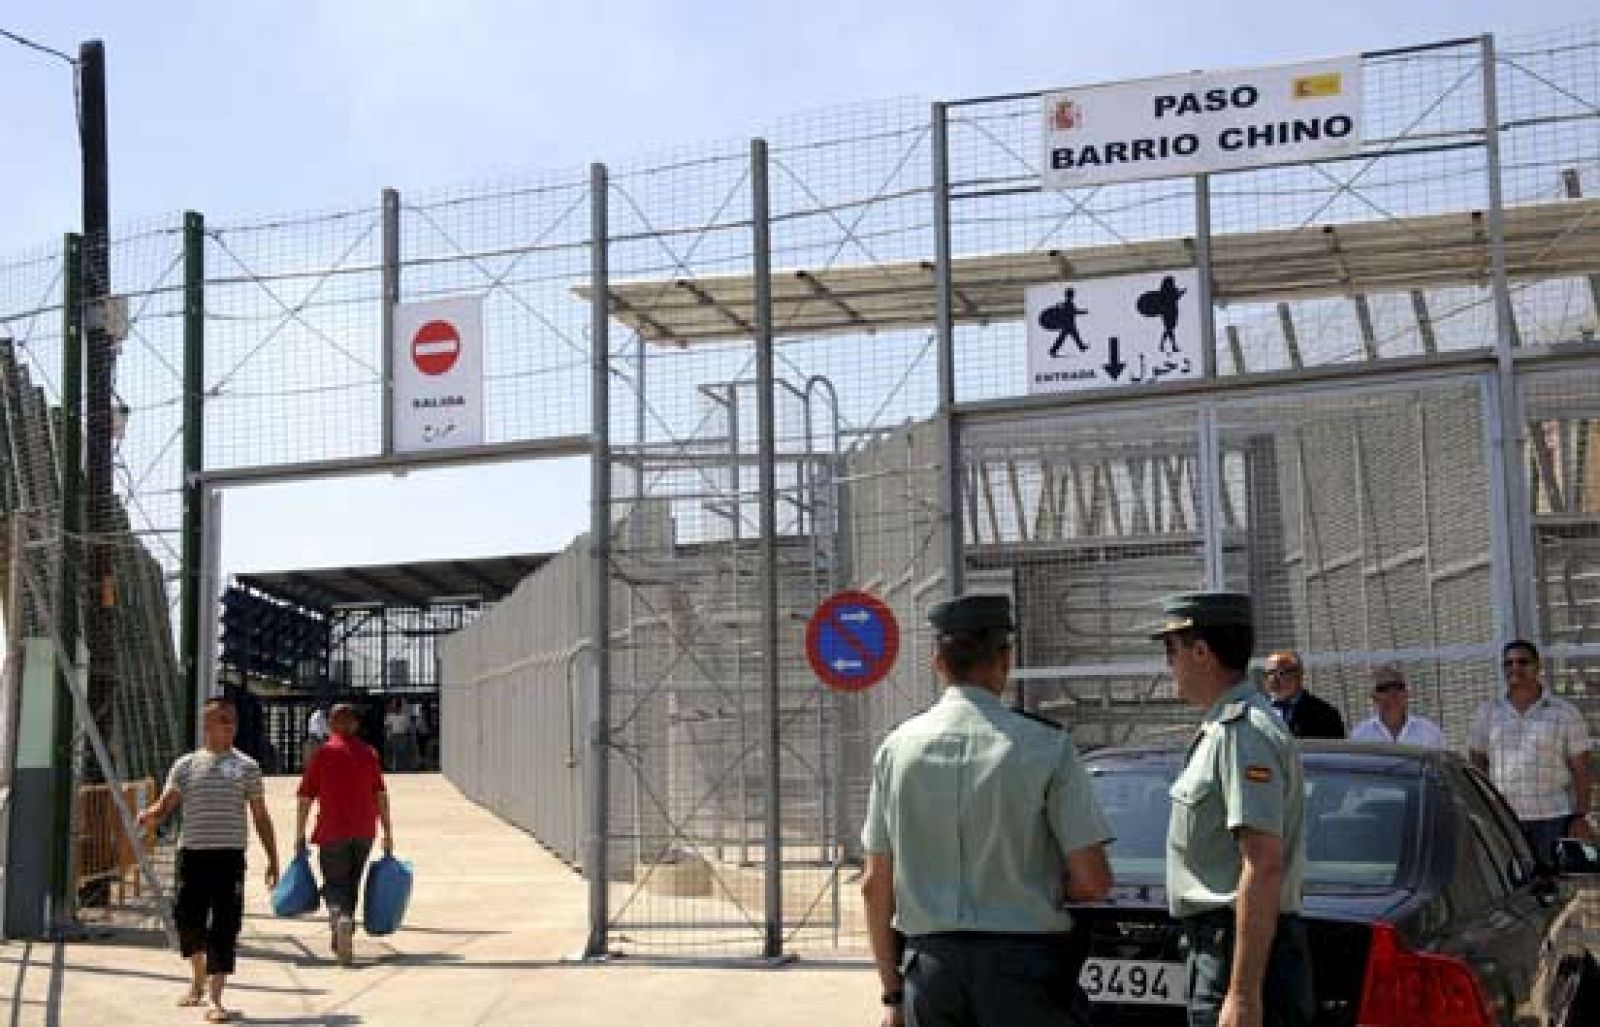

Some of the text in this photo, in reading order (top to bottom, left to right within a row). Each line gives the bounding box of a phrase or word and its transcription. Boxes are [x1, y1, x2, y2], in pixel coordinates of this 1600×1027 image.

[1154, 84, 1258, 119] PASO
[1050, 114, 1354, 170] BARRIO CHINO
[1035, 369, 1097, 382] ENTRADA
[412, 395, 466, 408] SALIDA
[1087, 963, 1168, 999] 3494
